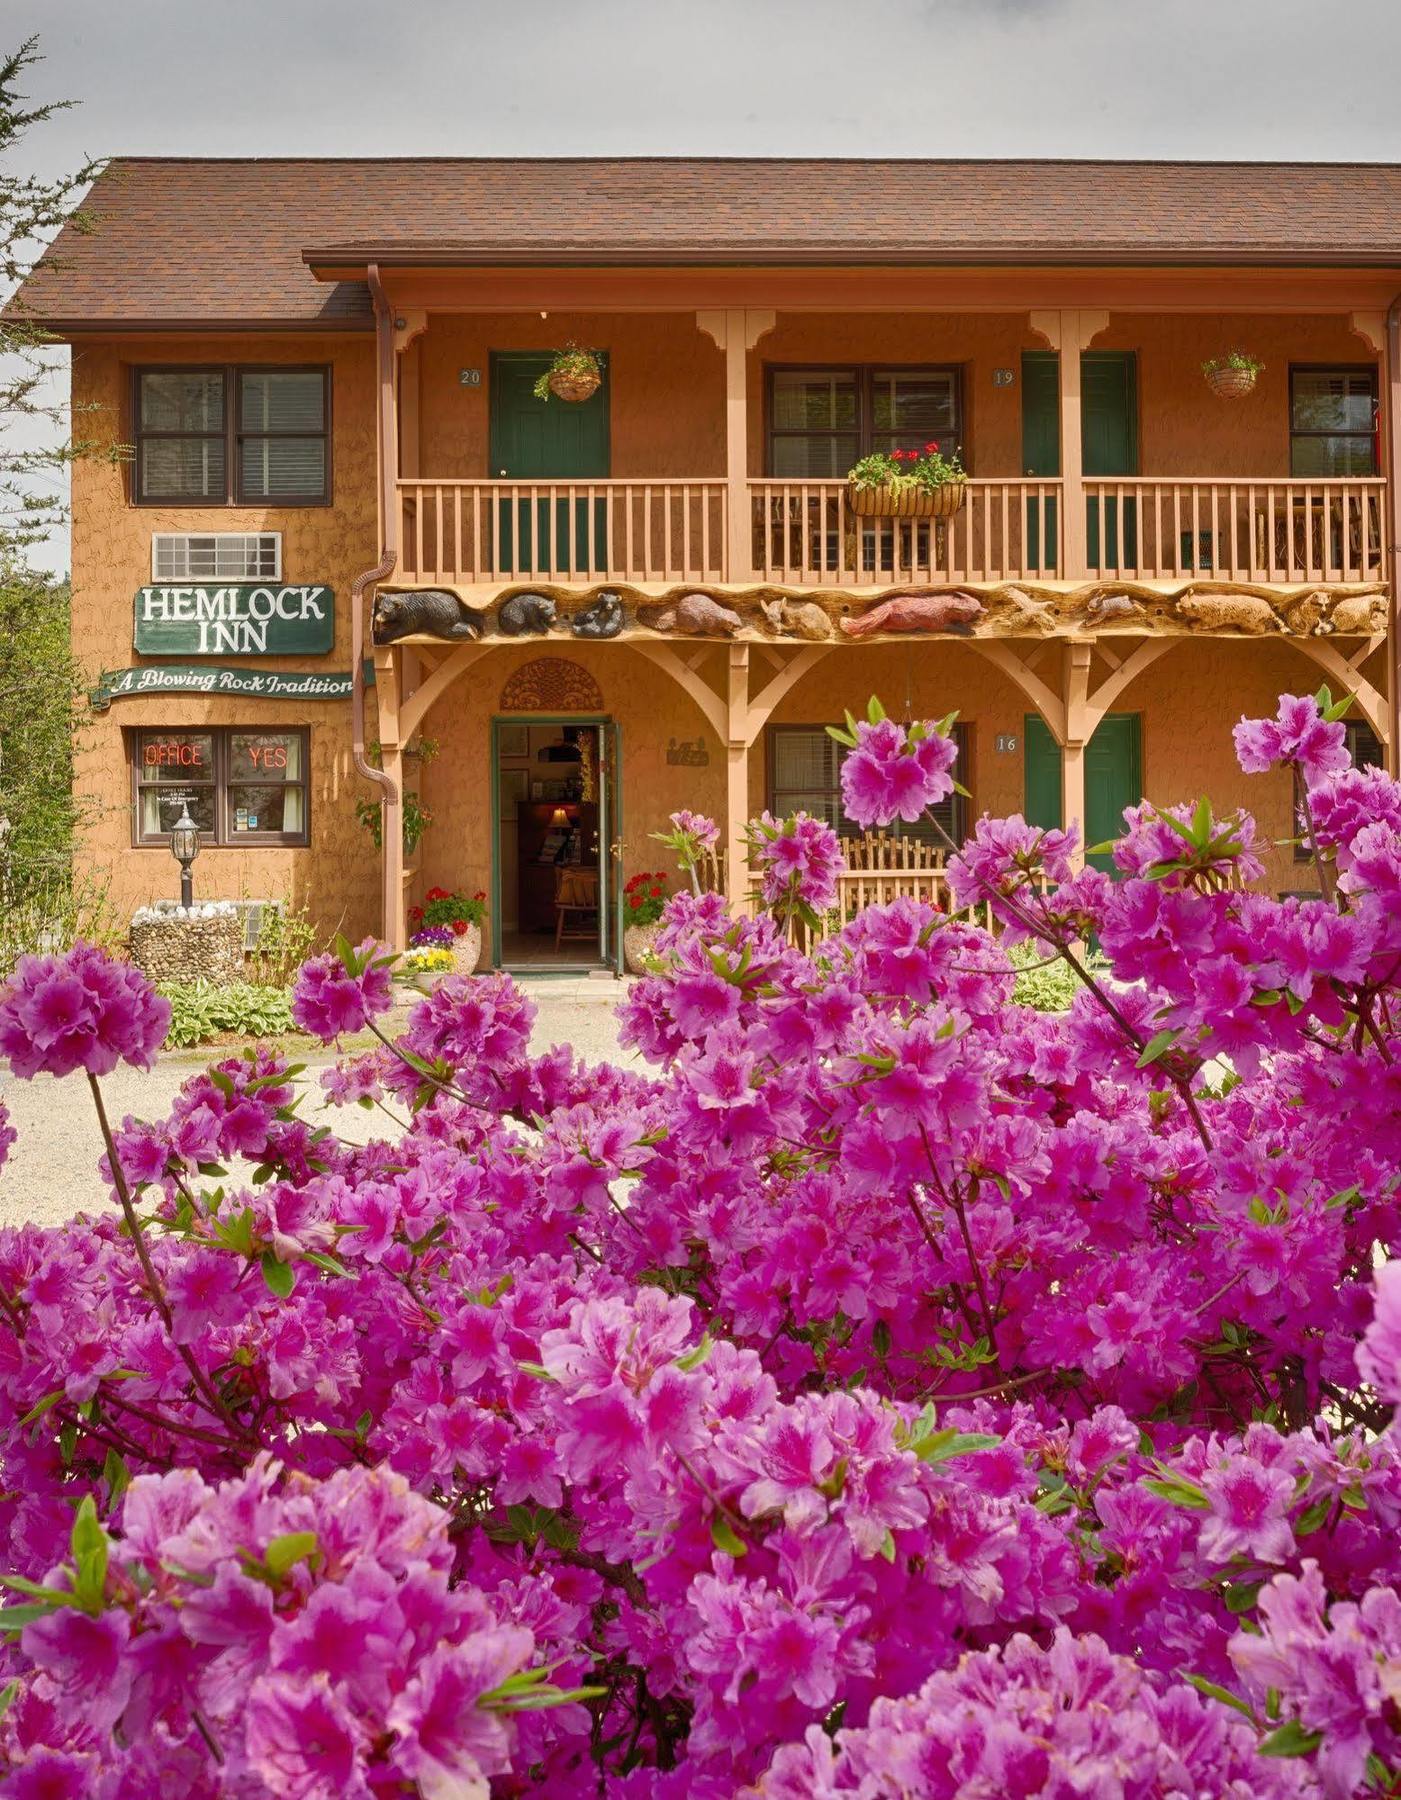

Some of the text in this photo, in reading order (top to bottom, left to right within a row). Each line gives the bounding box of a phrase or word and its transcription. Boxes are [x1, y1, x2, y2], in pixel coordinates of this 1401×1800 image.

[461, 371, 480, 383] 20
[996, 372, 1013, 384] 19
[141, 587, 325, 621] HEMLOCK
[197, 620, 269, 653] INN
[111, 672, 133, 693] A
[138, 670, 217, 692] Blowing
[267, 676, 353, 697] Tradition
[999, 738, 1016, 750] 16
[145, 745, 203, 767] OFFICE
[249, 747, 287, 768] YES
